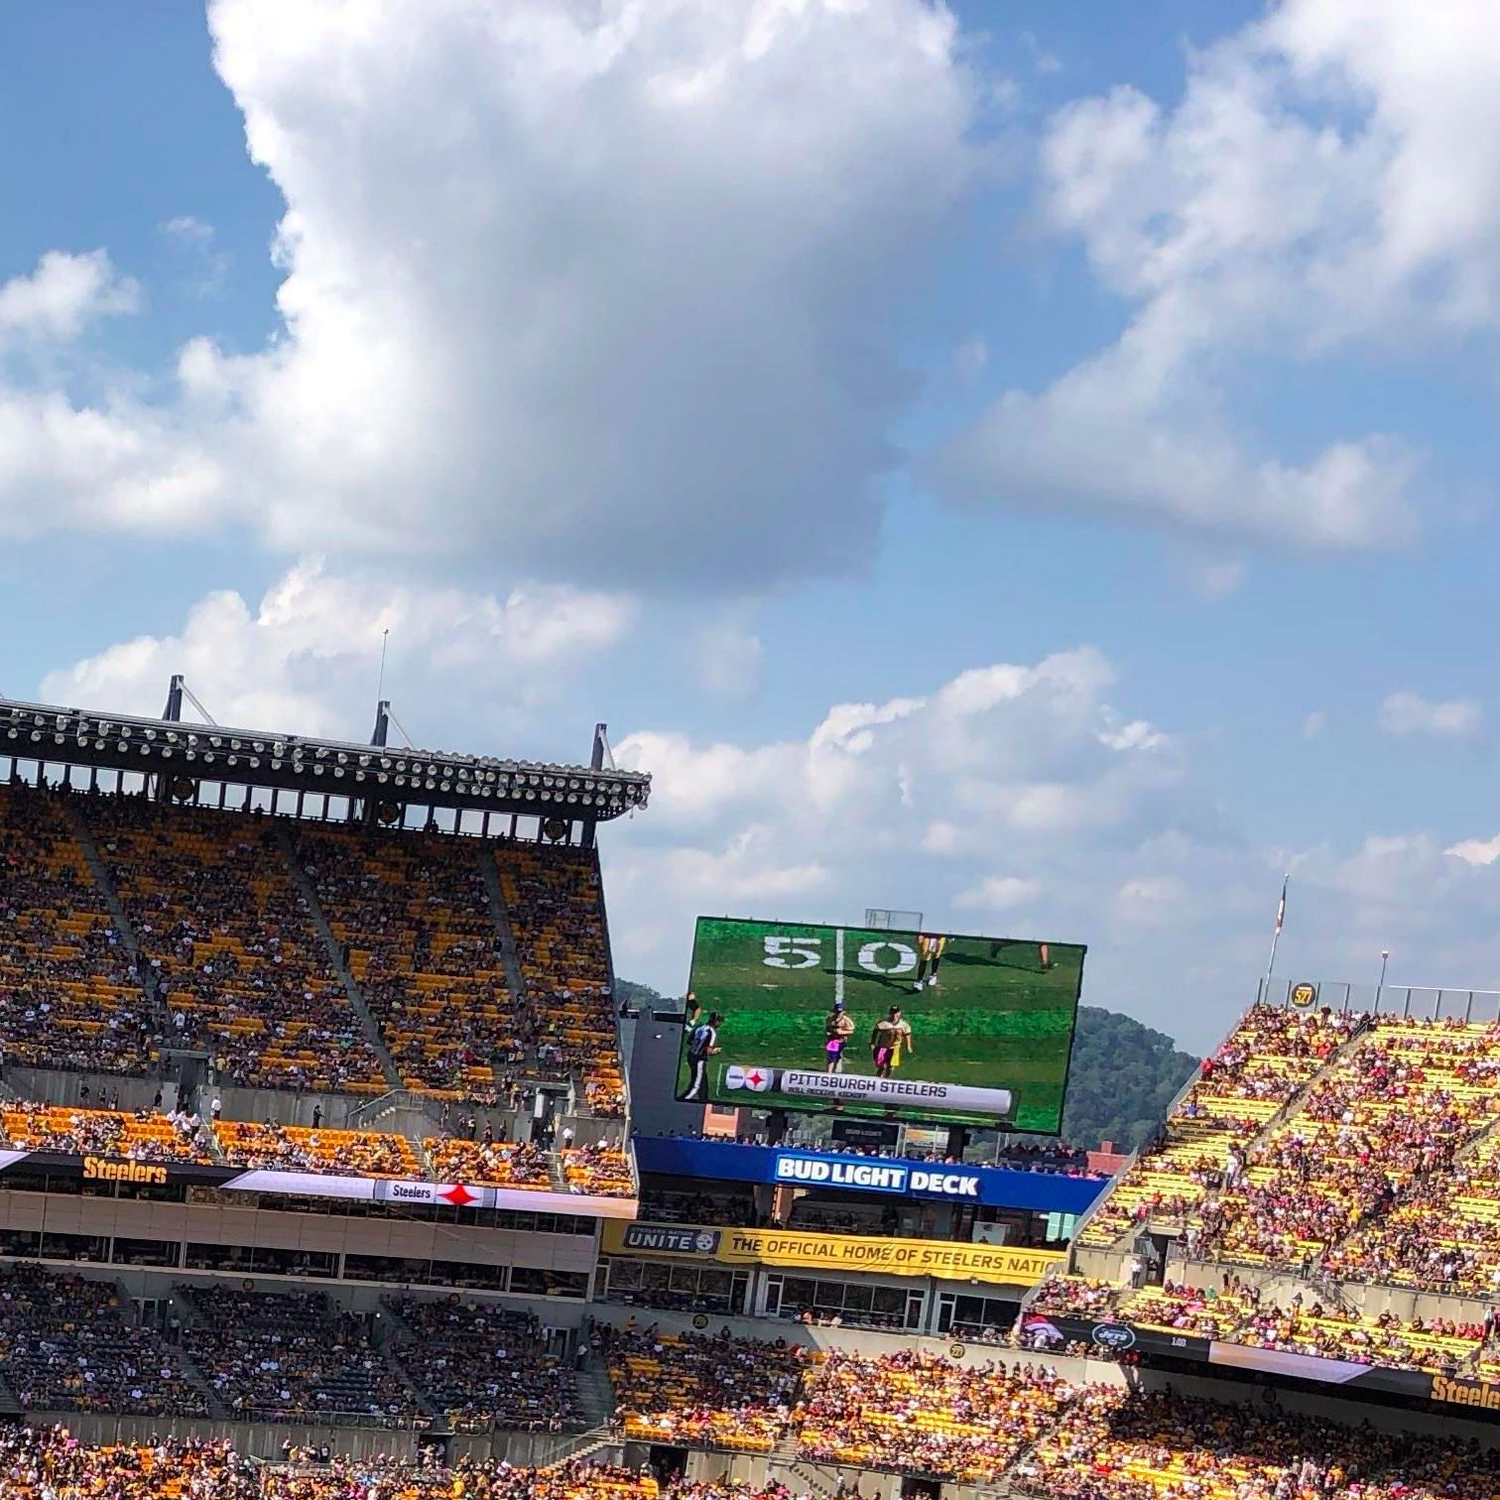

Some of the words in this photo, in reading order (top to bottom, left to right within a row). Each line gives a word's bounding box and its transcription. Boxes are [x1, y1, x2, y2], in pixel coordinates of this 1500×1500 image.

[1294, 990, 1312, 1004] 527
[788, 1073, 876, 1092] PITTSBURGH
[879, 1081, 948, 1098] STEELERS
[82, 1156, 167, 1185] Steelers
[777, 1157, 829, 1180] BUD
[831, 1163, 905, 1188] LIGHT
[909, 1171, 980, 1196] DECK
[391, 1183, 432, 1201] Steelers
[628, 1232, 692, 1250] UNITE
[731, 1237, 763, 1252] THE
[767, 1240, 838, 1257] OFFICIAL
[842, 1245, 892, 1261] HOME
[895, 1248, 918, 1262] OF
[921, 1250, 1003, 1270] STEELERS
